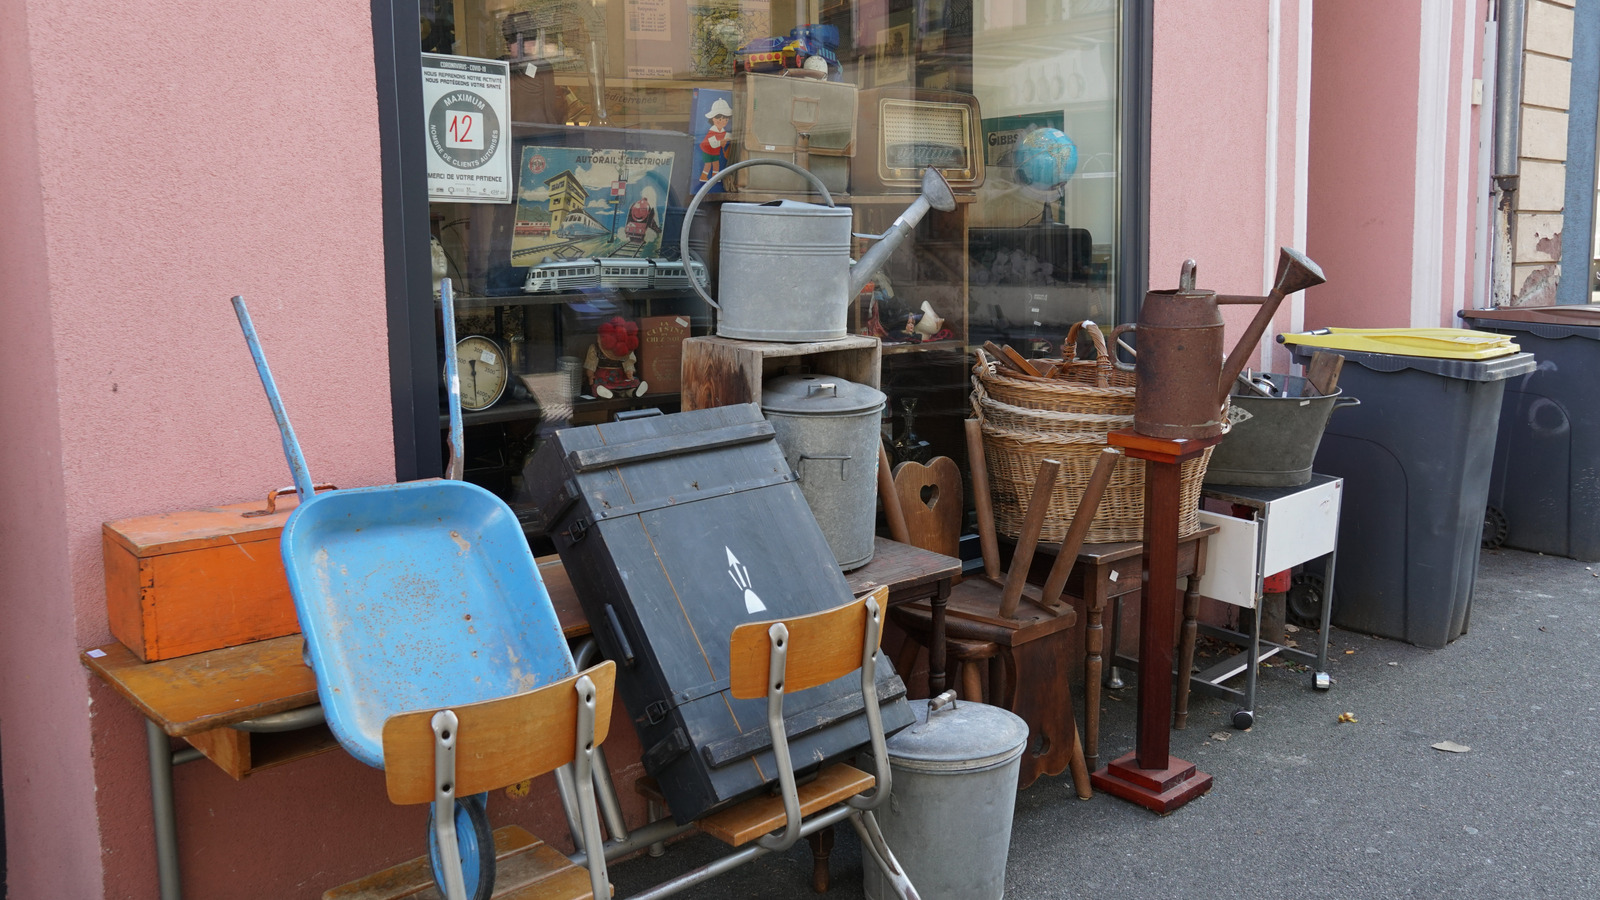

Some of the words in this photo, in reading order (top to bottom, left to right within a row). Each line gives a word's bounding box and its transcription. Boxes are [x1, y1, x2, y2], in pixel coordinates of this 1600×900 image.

[438, 72, 466, 80] REPRENONS
[443, 93, 486, 111] MAXIMUM
[449, 114, 473, 143] 12
[430, 124, 445, 154] NOMBRE
[442, 152, 452, 163] DE
[452, 159, 480, 168] CLIENTS
[575, 155, 617, 164] AUTORAIL
[427, 172, 446, 180] MERCI
[475, 175, 503, 183] PATIENCE
